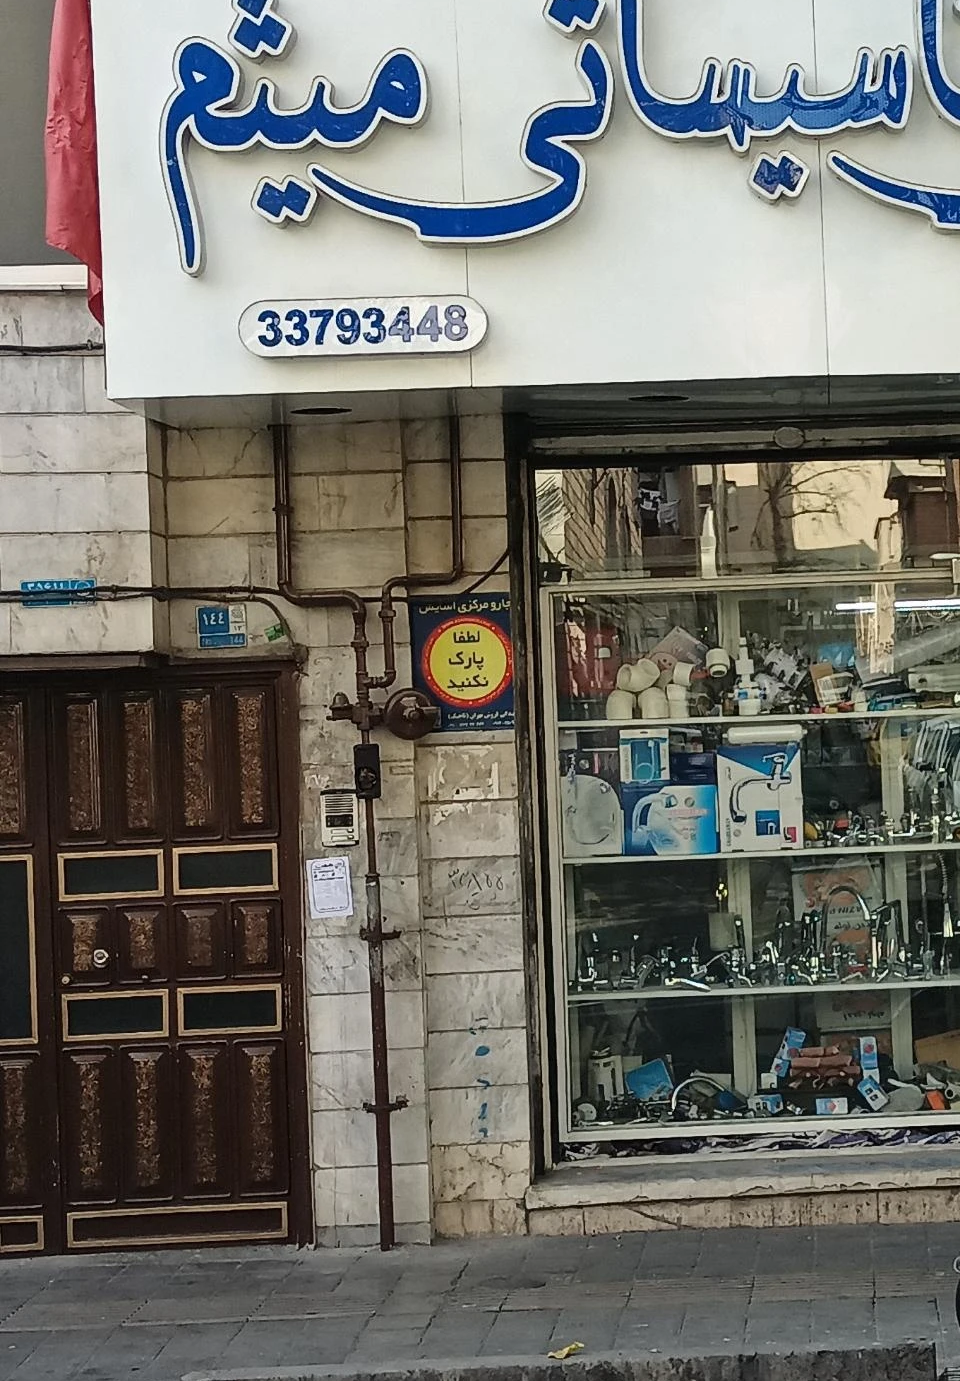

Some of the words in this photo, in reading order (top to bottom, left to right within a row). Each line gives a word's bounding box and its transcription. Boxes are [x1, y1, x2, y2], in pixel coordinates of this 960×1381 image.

[257, 304, 469, 347] 33793448
[453, 630, 480, 644] لطفا
[448, 651, 484, 670] پارک
[447, 674, 489, 692] نکنید
